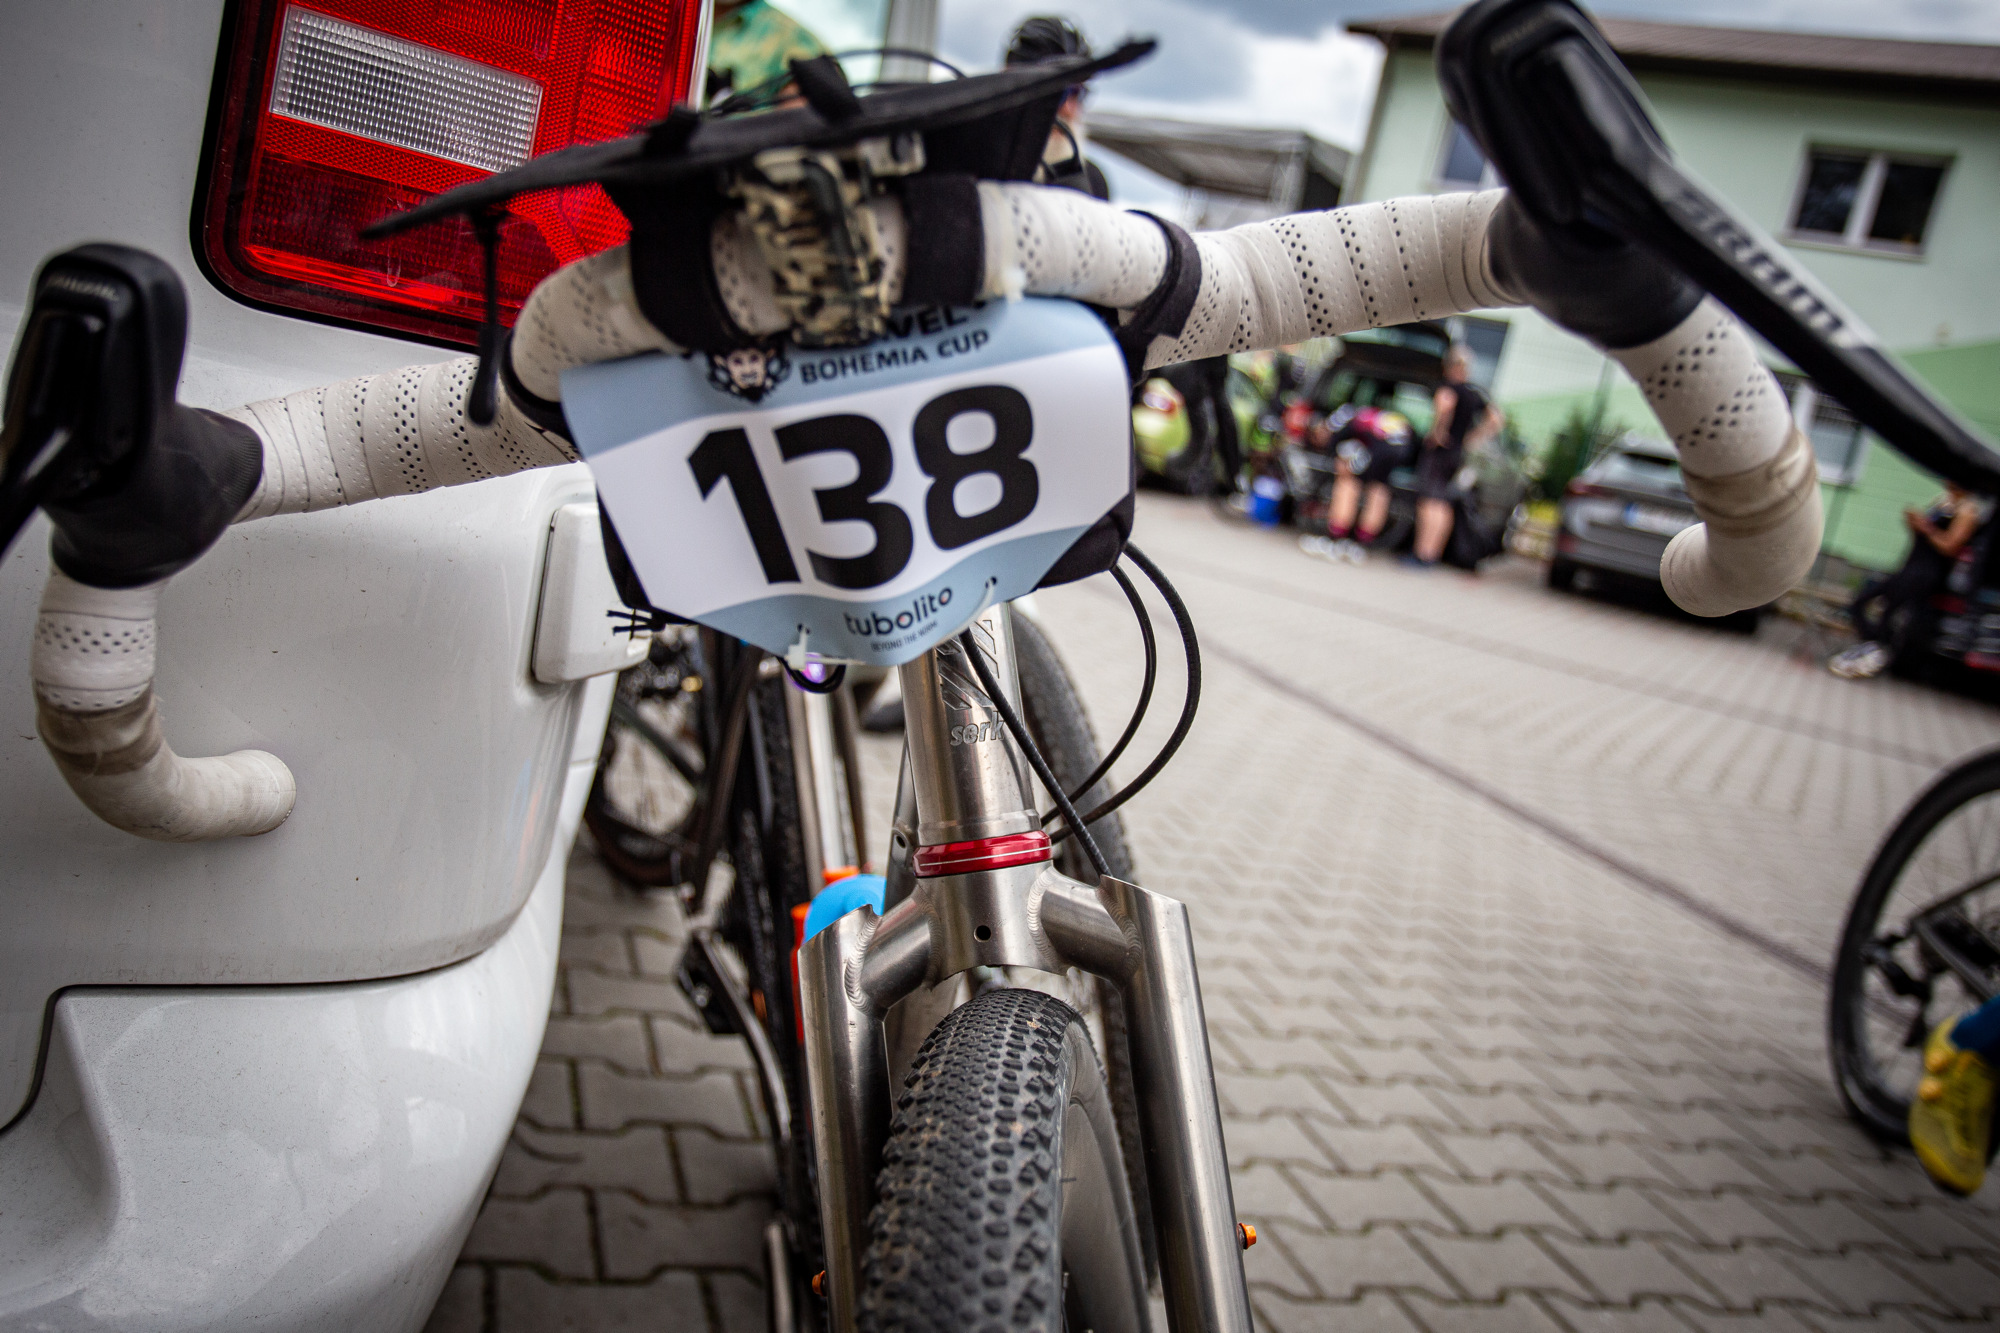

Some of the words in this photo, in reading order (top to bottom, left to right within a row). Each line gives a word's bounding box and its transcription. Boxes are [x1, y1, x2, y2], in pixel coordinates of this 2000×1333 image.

[878, 303, 968, 340] VEL
[801, 346, 928, 385] BOHEMIA
[938, 329, 989, 358] CUP
[687, 384, 1039, 589] 138
[843, 587, 953, 636] tubolito
[904, 632, 917, 644] THE
[950, 710, 1005, 746] serk
